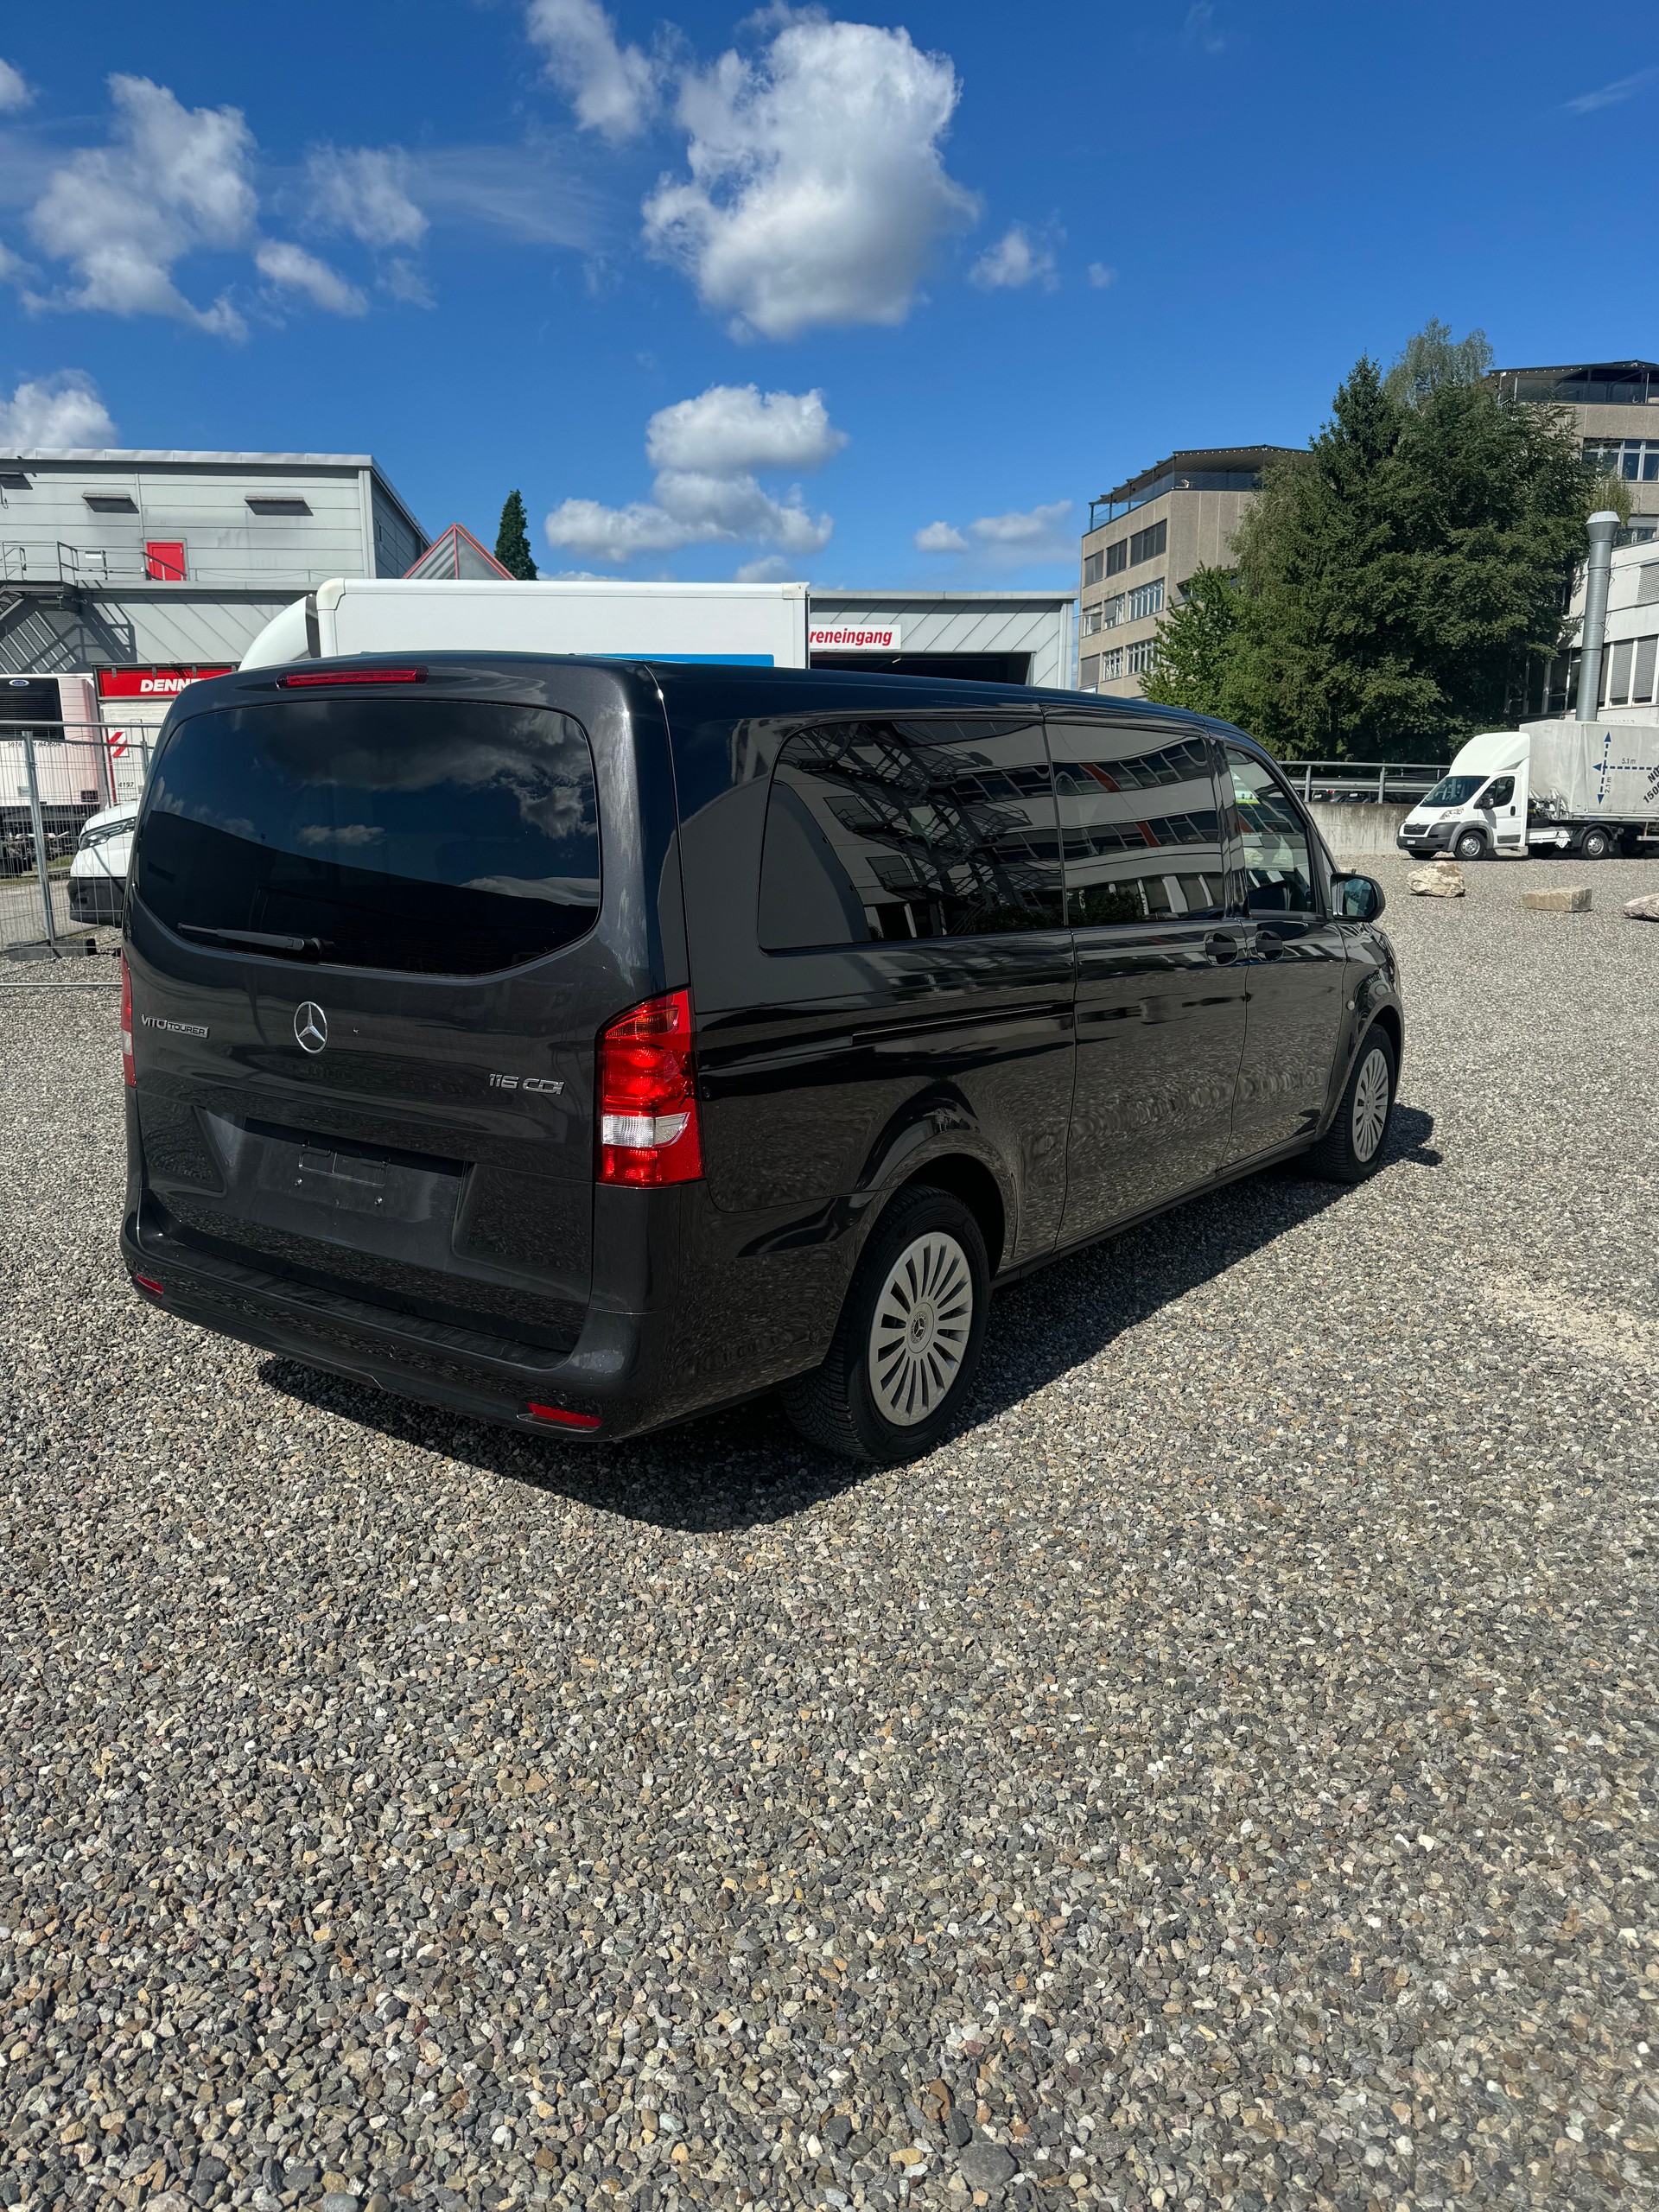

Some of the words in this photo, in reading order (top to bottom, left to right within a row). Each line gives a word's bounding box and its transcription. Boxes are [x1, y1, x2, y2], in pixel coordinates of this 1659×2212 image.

[810, 627, 893, 646] reneingang
[140, 677, 205, 692] DENN
[1647, 765, 1659, 784] NU
[141, 1014, 168, 1030] VITO
[168, 1022, 206, 1036] TOURER
[489, 1073, 519, 1090] 116
[522, 1077, 565, 1095] CDI
